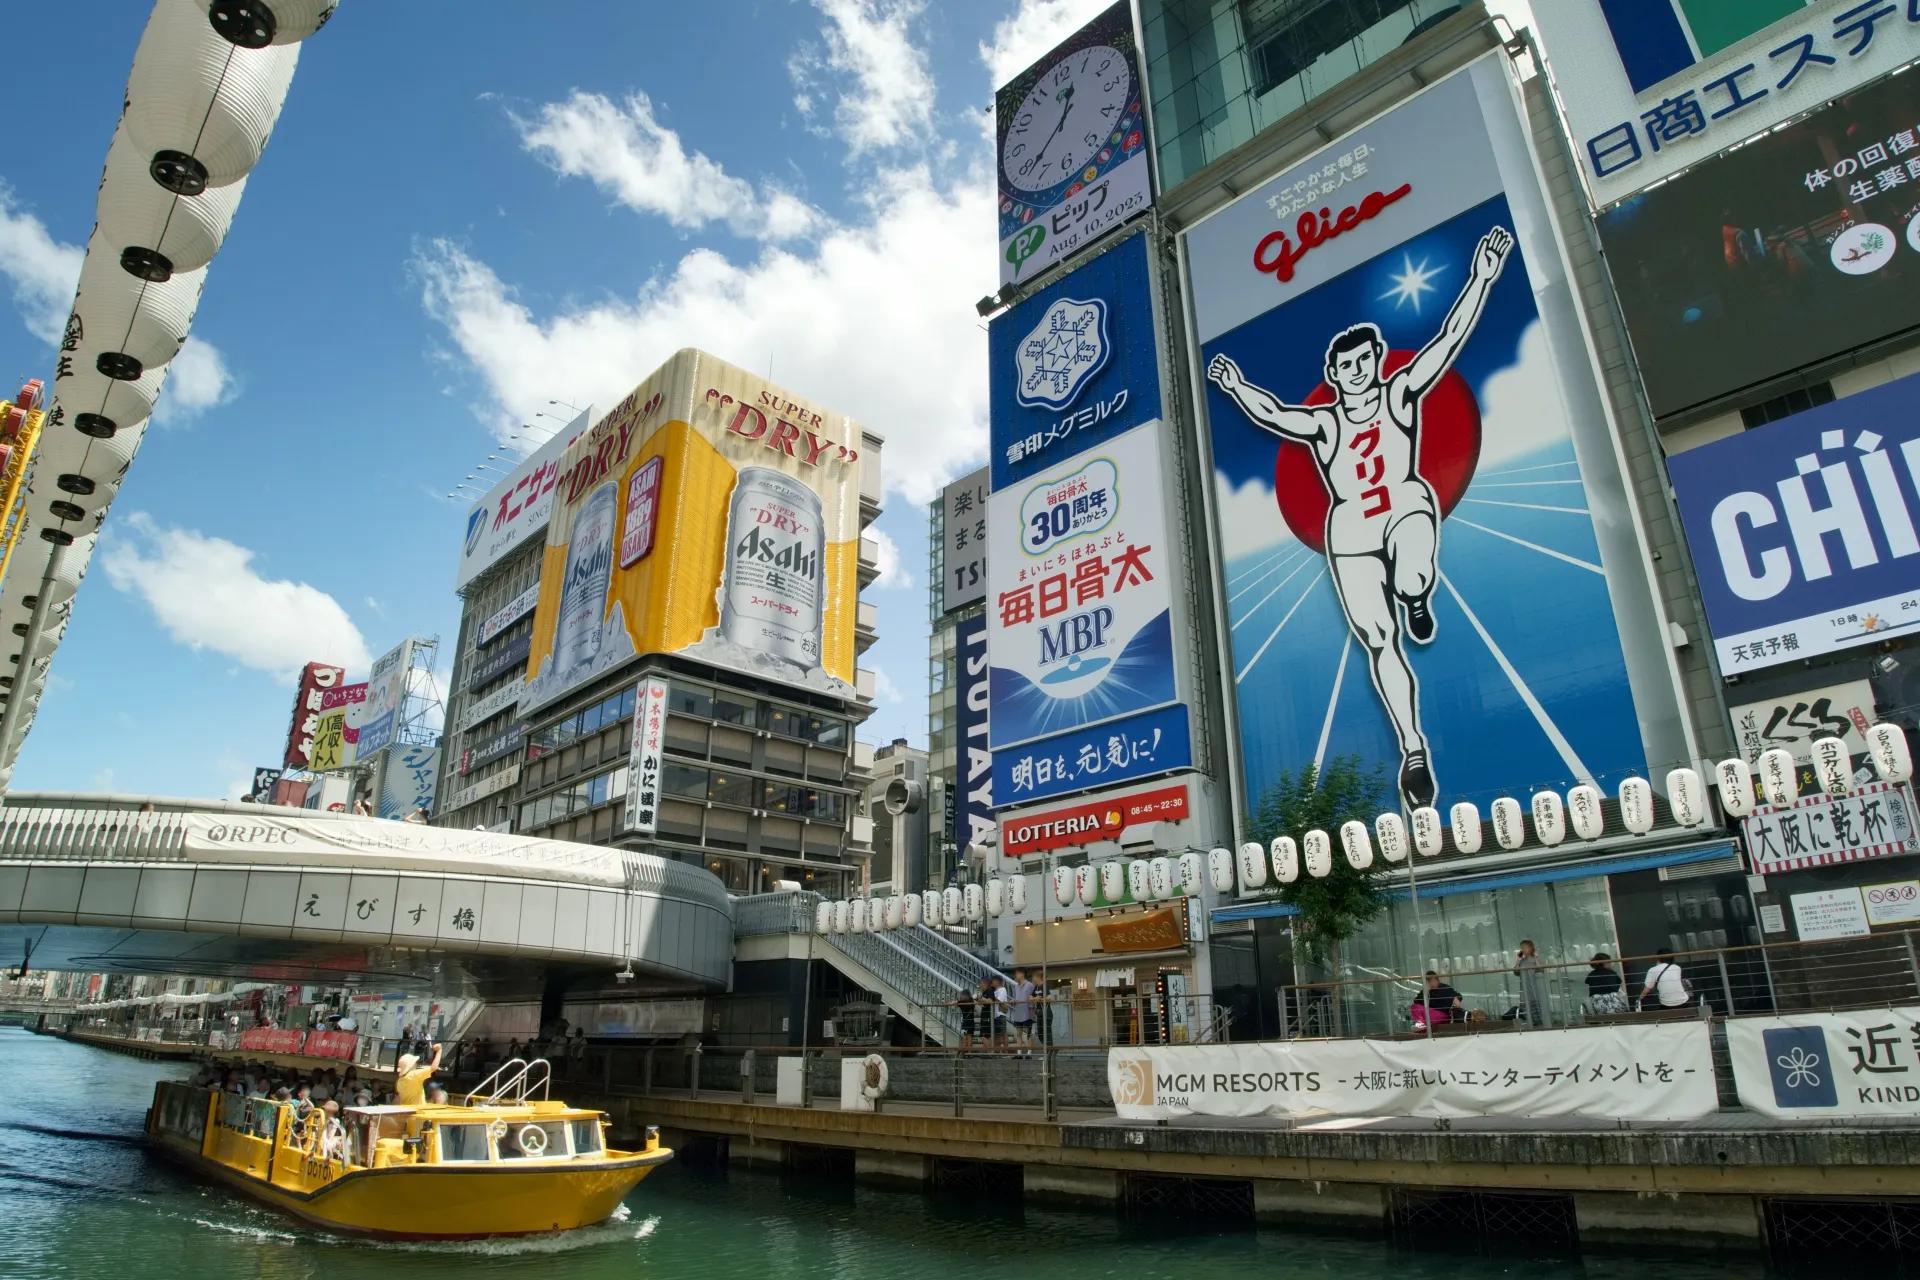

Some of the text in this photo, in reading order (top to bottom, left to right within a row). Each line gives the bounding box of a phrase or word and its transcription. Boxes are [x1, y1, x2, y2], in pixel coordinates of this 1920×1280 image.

[1053, 66, 1070, 87] 12
[1080, 57, 1089, 73] 1
[1095, 59, 1111, 77] 2
[1031, 88, 1048, 107] 11
[1103, 75, 1120, 92] 3
[1587, 0, 1920, 178] 日商エステ
[1016, 113, 1033, 136] 10
[1101, 103, 1115, 118] 4
[1011, 143, 1026, 158] 9
[1084, 132, 1098, 147] 5
[1019, 158, 1033, 176] 8
[1038, 162, 1053, 180] 7
[1061, 153, 1073, 170] 6
[1266, 143, 1375, 209] すこやかな毎日、
[1804, 125, 1920, 193] 体の回復
[1052, 179, 1110, 235] ピップ
[1276, 162, 1368, 219] ゆたかな人生
[1049, 234, 1081, 257] Aug.
[1084, 220, 1103, 238] 10,
[588, 393, 636, 446] SUPER
[758, 390, 822, 428] SUPER
[1006, 389, 1129, 465] 雪印メグミルク
[629, 465, 657, 502] ASAHI
[1348, 420, 1392, 519] グリコ
[768, 502, 797, 518] SUPER
[1046, 481, 1088, 506] 毎日骨太
[626, 498, 652, 534] 1889
[1031, 488, 1107, 546] 30 周年
[1072, 507, 1108, 529] ありがとう
[621, 527, 650, 562] OSAKA
[737, 526, 816, 581] Asahi
[1019, 531, 1125, 581] まいにちほねぶと
[566, 541, 610, 595] Asahi
[766, 571, 785, 590] 生
[955, 557, 986, 591] TS
[998, 544, 1154, 628] 毎日骨太
[751, 596, 799, 617] スーパードライ
[1901, 599, 1920, 611] 24
[1039, 606, 1113, 665] MBP
[1732, 633, 1800, 664] 天気予報
[314, 717, 331, 768] バイト
[326, 714, 345, 766] 高収入
[648, 703, 660, 750] 本場の味
[639, 755, 658, 825] かに道楽
[1008, 814, 1099, 845] LOTTERIA
[1755, 799, 1887, 861] 大阪に乾杯
[1889, 799, 1907, 830] 検索
[302, 893, 475, 932] えびす橋
[1157, 1072, 1320, 1093] MGM RESORTS
[1157, 1096, 1189, 1106] JAPAN
